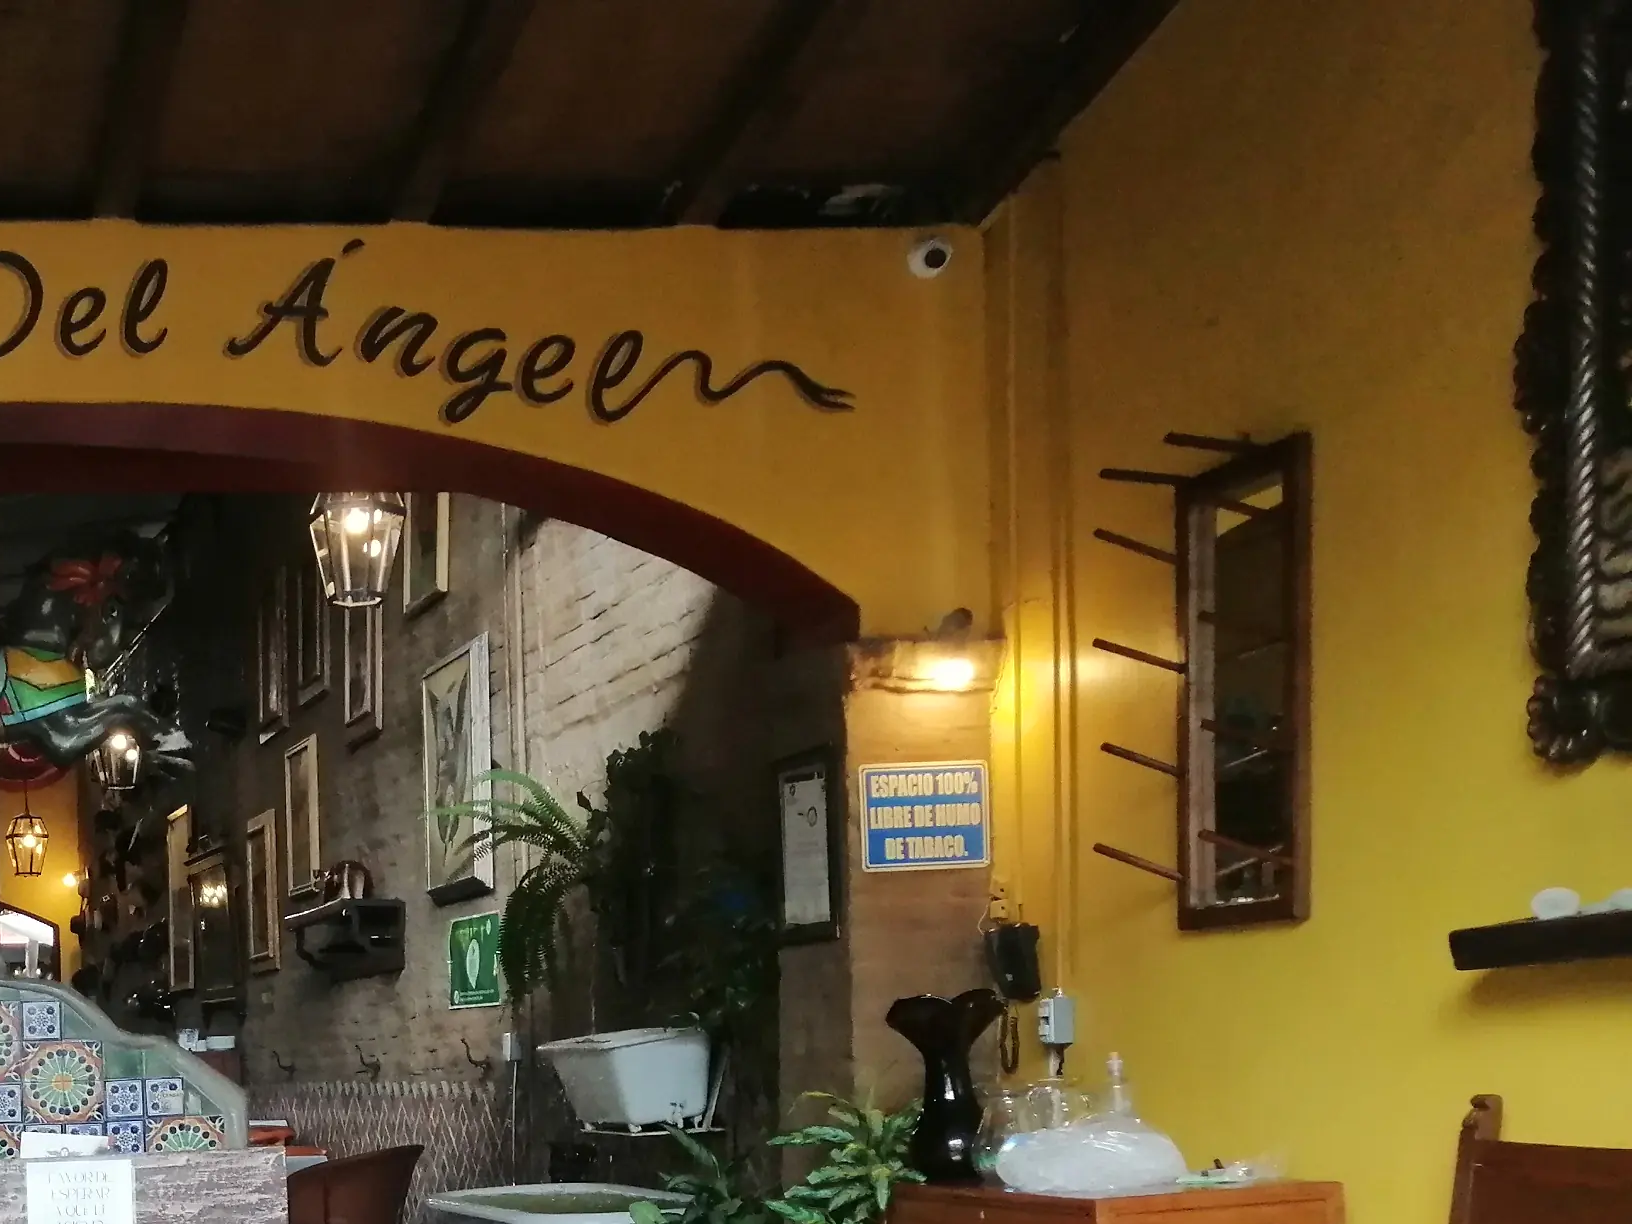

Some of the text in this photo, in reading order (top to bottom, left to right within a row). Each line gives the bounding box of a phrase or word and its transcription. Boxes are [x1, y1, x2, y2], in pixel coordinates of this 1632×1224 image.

[226, 238, 856, 424] Ángel
[870, 771, 979, 798] ESPACIO 100%
[869, 802, 981, 829] LIBRE DE HUMO
[884, 834, 969, 860] DE TABACO.
